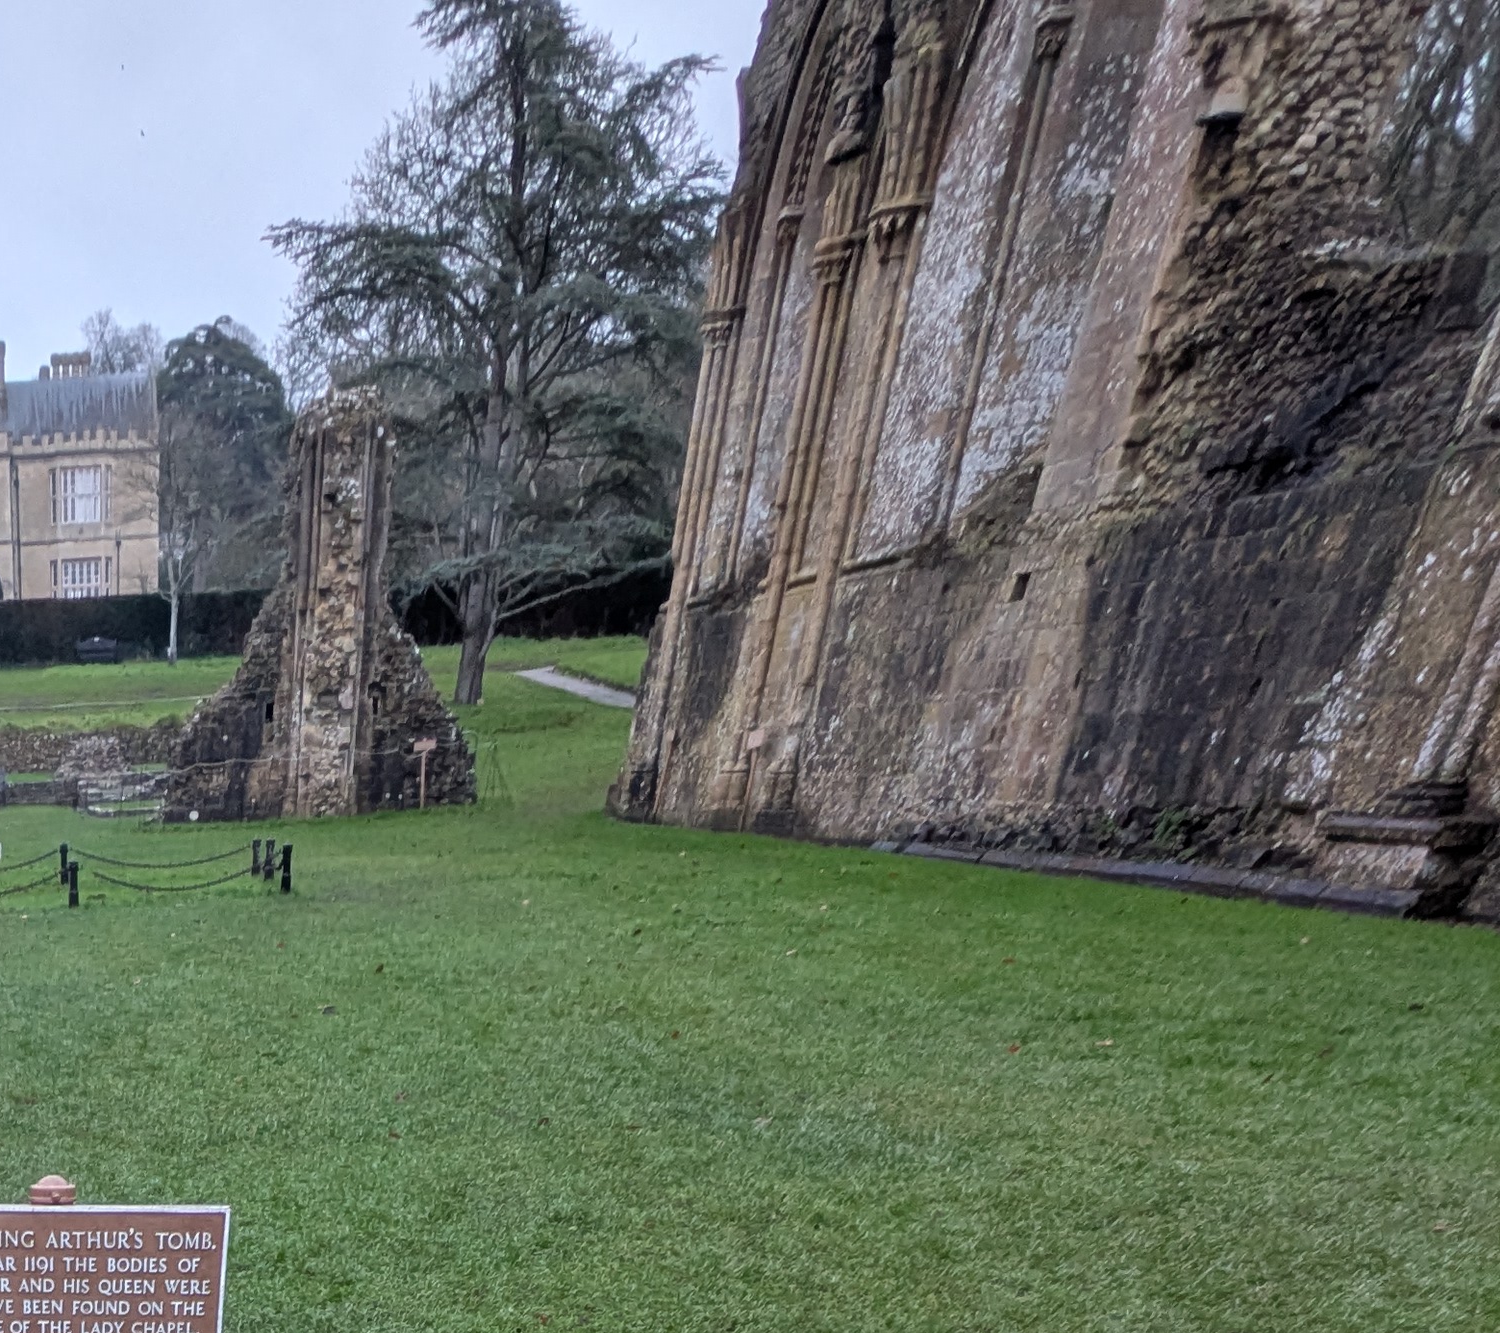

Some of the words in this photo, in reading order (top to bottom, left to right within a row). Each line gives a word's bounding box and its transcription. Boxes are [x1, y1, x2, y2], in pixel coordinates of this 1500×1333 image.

[45, 1227, 143, 1249] ARTHUR'S
[155, 1231, 216, 1250] TOMB.
[24, 1256, 54, 1275] 1191
[62, 1257, 97, 1272] THE
[107, 1257, 167, 1273] BODIES
[178, 1257, 201, 1273] OF
[18, 1278, 55, 1293] AND
[63, 1278, 90, 1294] HIS
[98, 1278, 155, 1296] QUEEN
[164, 1279, 211, 1295] WERE
[23, 1299, 64, 1314] BEEN
[72, 1300, 130, 1315] FOUND
[138, 1301, 164, 1316] ON
[170, 1300, 205, 1316] THE
